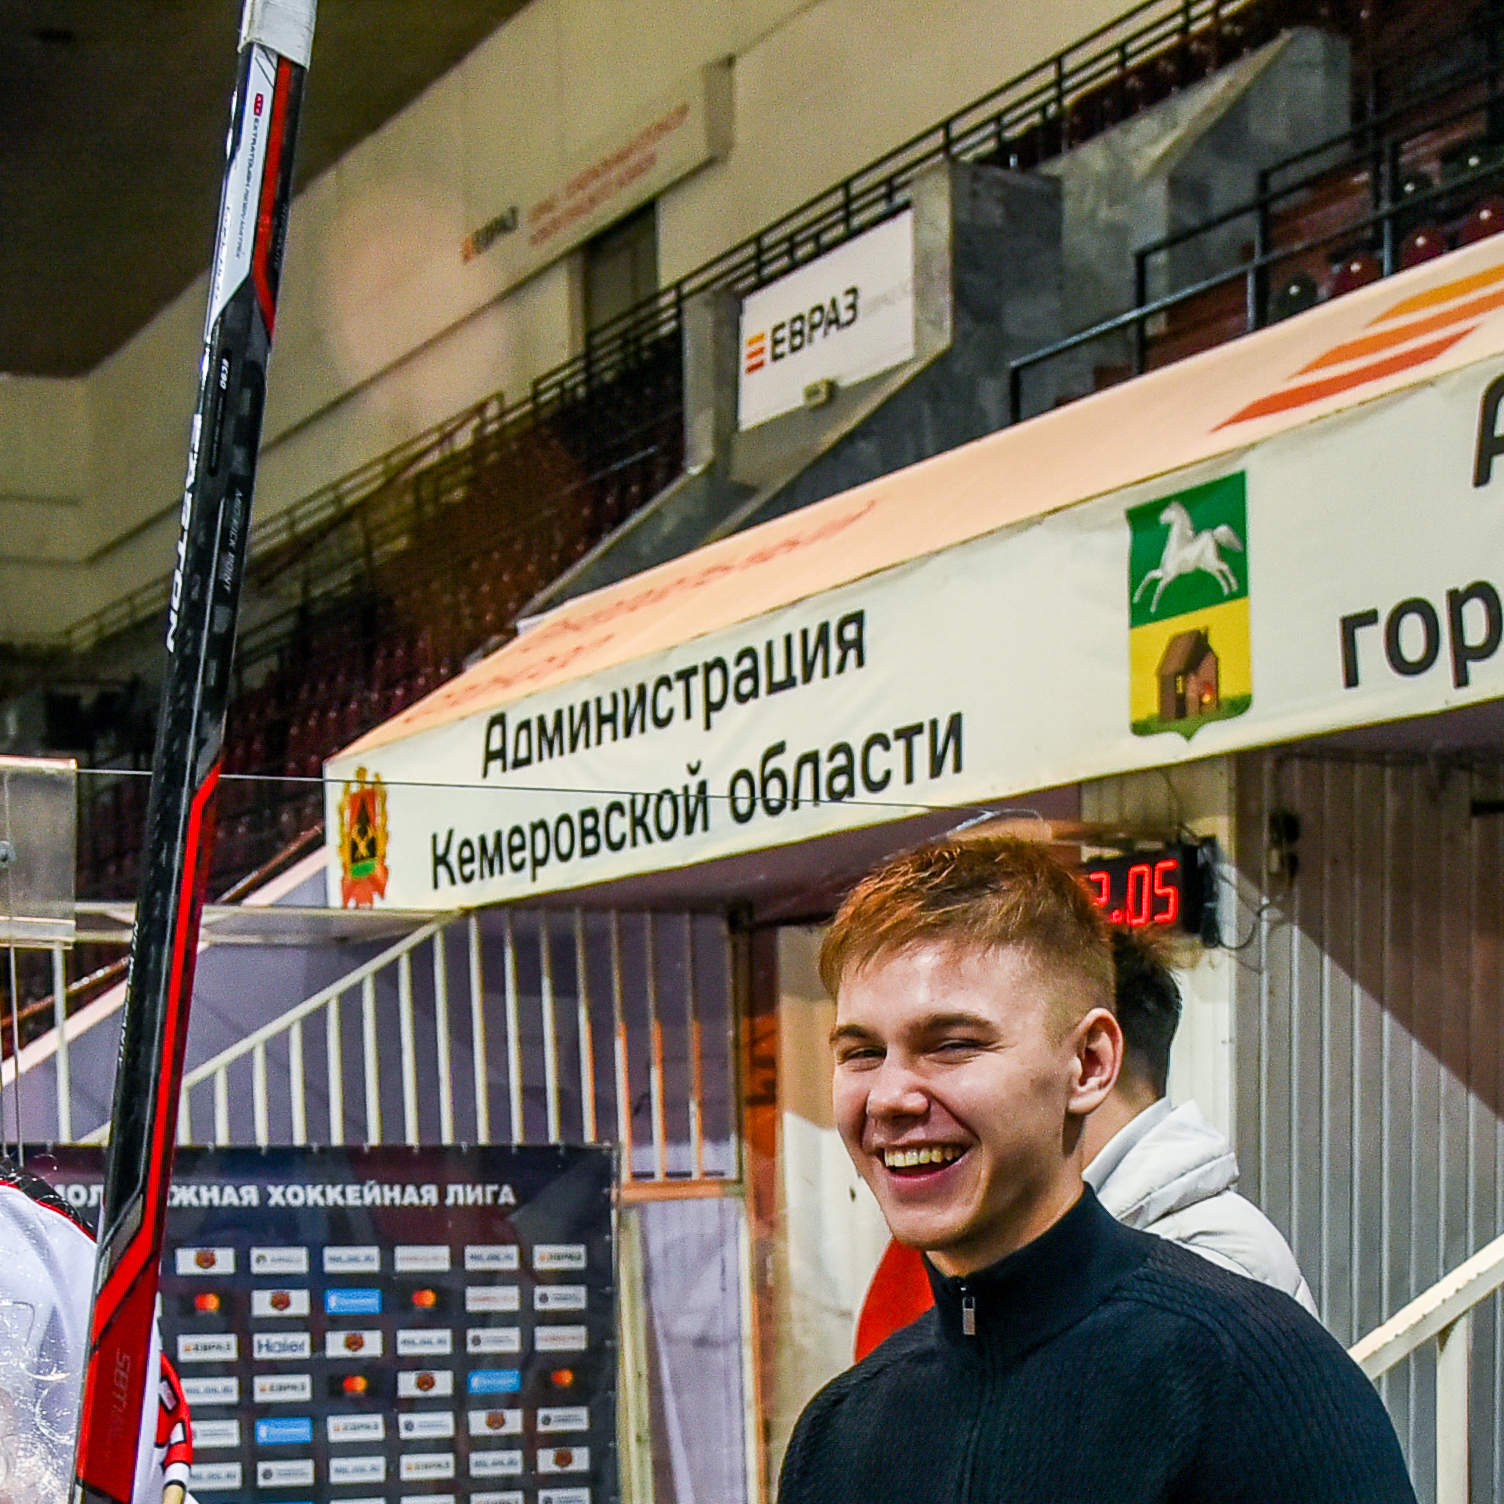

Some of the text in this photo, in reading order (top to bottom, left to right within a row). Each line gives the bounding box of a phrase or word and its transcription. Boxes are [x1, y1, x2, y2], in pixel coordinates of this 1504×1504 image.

[770, 286, 859, 362] ЕВРАЗ
[481, 609, 867, 779] Администрация
[432, 711, 966, 891] Кемеровской области
[266, 1179, 439, 1208] ХОККЕЙНАЯ
[444, 1184, 516, 1207] ЛИГА
